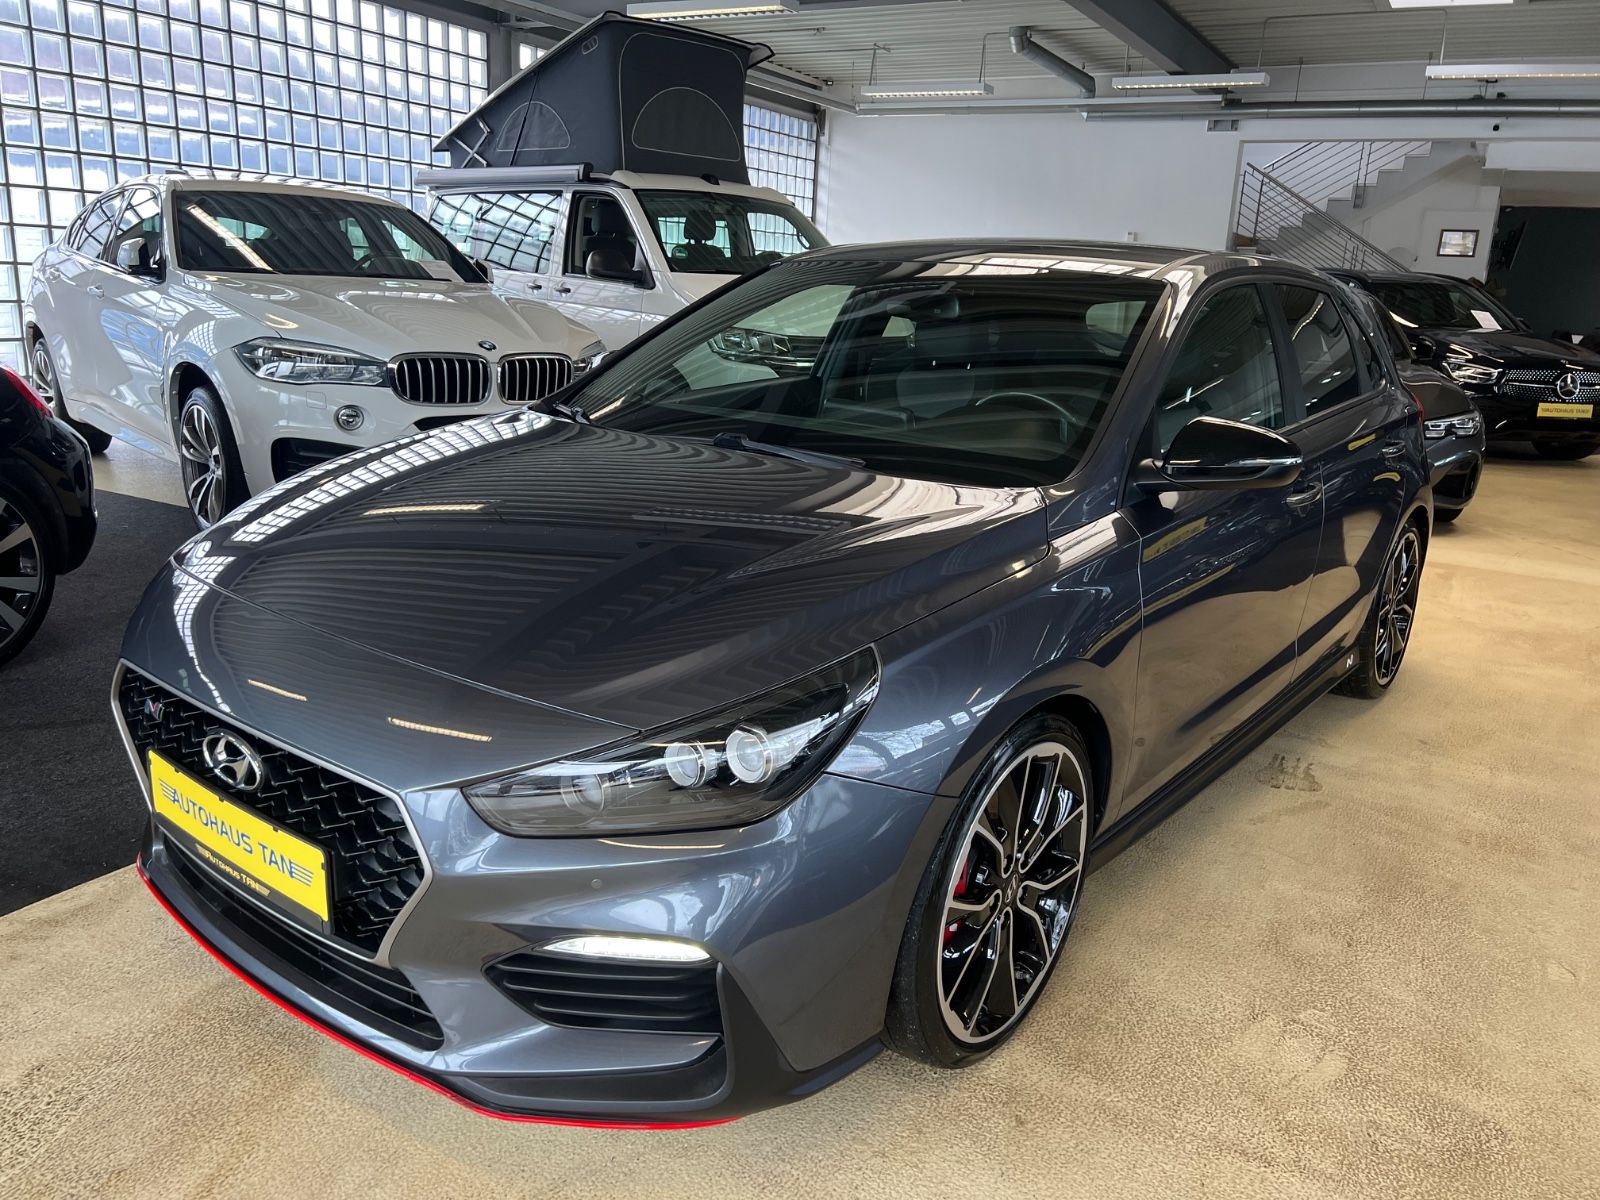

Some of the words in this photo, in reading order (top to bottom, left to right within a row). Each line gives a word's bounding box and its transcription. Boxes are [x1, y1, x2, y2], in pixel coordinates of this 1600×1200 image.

[172, 788, 254, 855] AUTOHAUS
[257, 841, 295, 879] TAN
[240, 873, 260, 892] TAN
